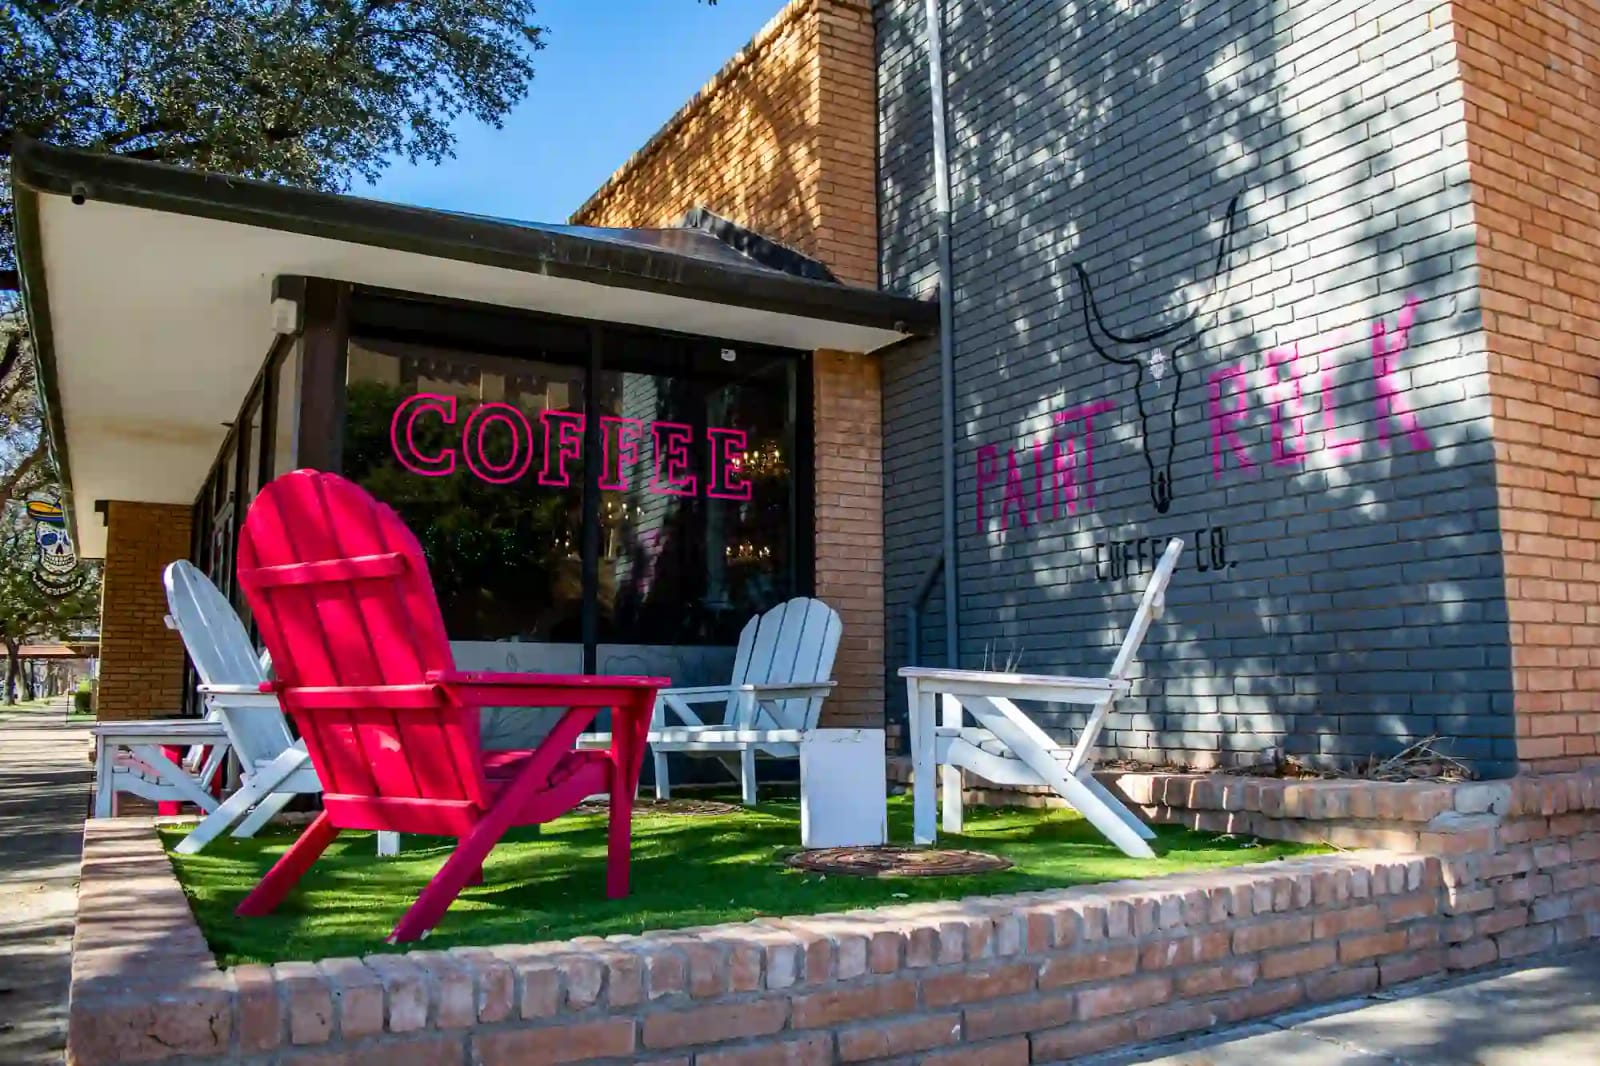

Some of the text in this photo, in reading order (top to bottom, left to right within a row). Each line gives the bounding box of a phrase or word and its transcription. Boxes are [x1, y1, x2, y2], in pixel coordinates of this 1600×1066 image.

[391, 393, 752, 499] COFFEE
[976, 400, 1115, 533] PAINT
[1195, 527, 1238, 572] CO.
